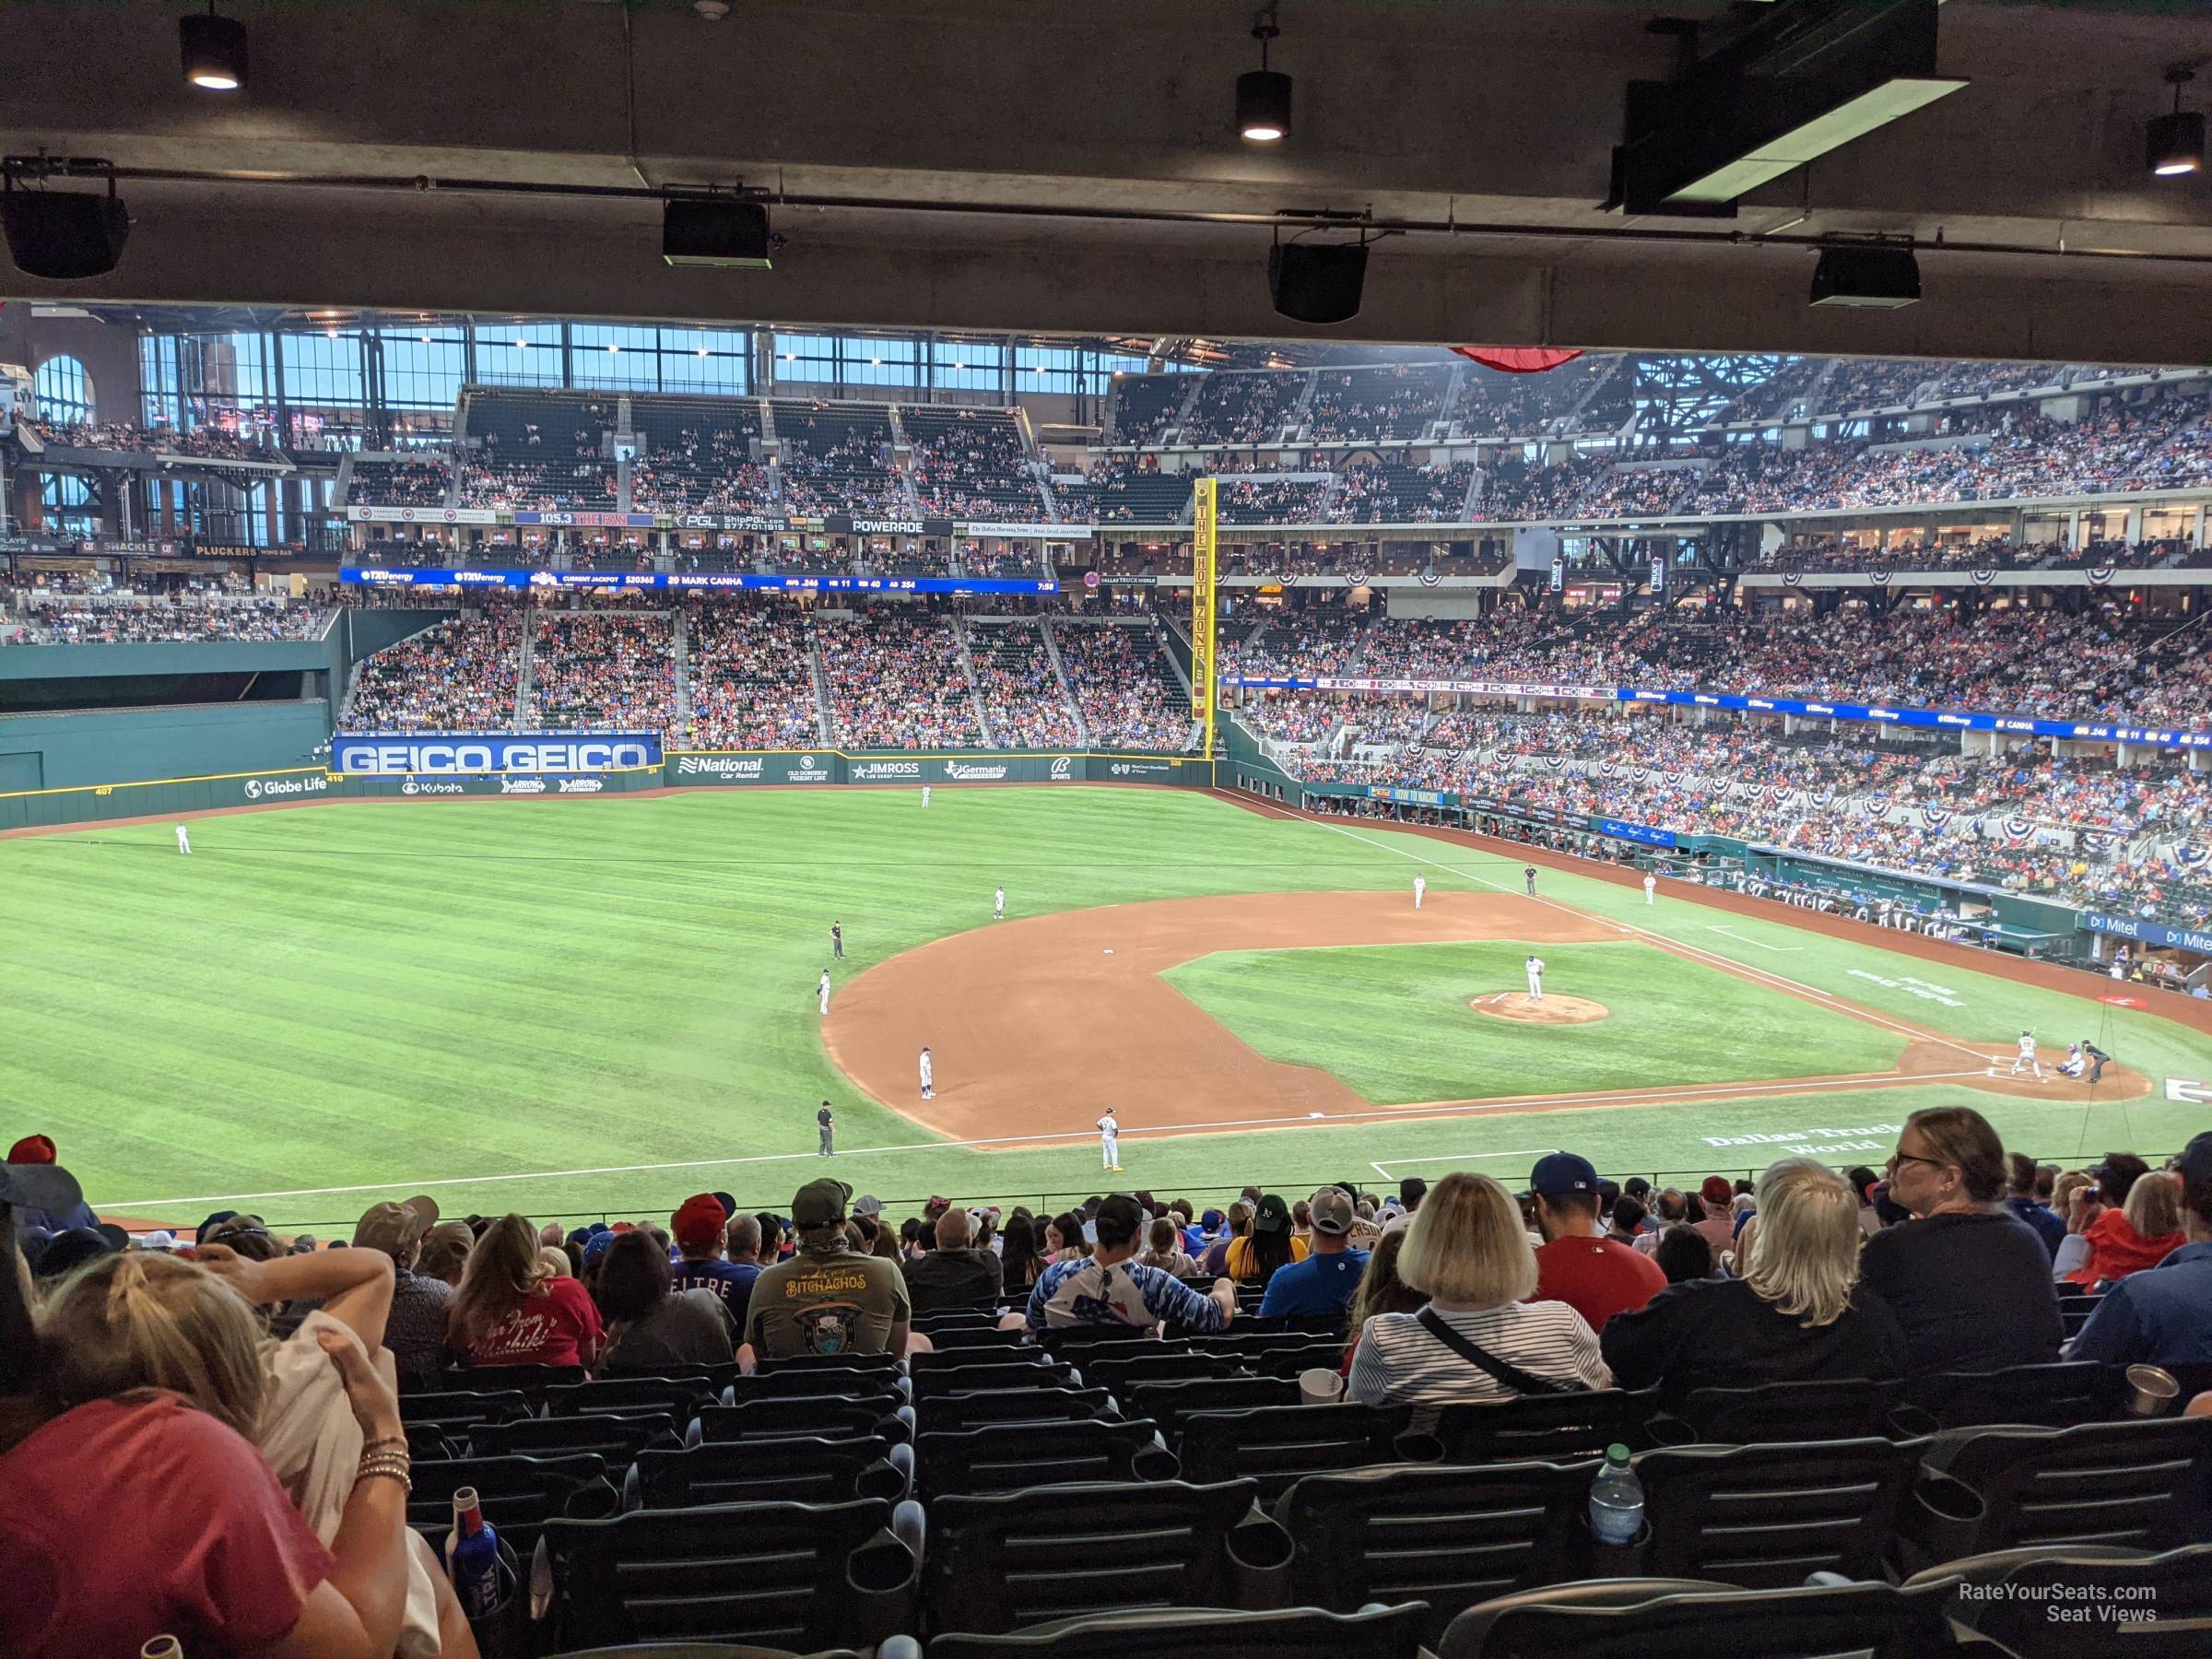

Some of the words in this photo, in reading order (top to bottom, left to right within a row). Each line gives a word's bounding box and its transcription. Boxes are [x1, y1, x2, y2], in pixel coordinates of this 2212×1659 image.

[539, 513, 572, 524] 105.3
[574, 514, 601, 524] THE
[602, 515, 628, 525] FAN
[687, 516, 718, 526] PGL
[724, 516, 784, 524] ShipPGL.com
[853, 520, 924, 533] POWERADE
[1197, 507, 1206, 546] THE
[195, 547, 257, 556] PLUCKERS
[370, 571, 414, 582] TXUenergy
[463, 572, 506, 582] TXUenergy
[667, 576, 679, 584] 20
[681, 576, 709, 584] MARK
[710, 577, 743, 585] CANHA
[1196, 558, 1206, 595] HOT
[1195, 606, 1206, 659] ZONE
[2006, 720, 2034, 730] CANHA
[341, 745, 493, 773] GEICO
[502, 744, 648, 771] GEICO
[962, 764, 1006, 774] Germania
[326, 774, 344, 783] 410
[512, 780, 541, 789] ARROW
[569, 779, 597, 788] ARROW
[95, 787, 112, 795] 407
[264, 781, 301, 794] Globe
[304, 779, 327, 792] Life
[421, 782, 465, 794] Kubota
[2106, 917, 2138, 936] Mitel
[2183, 933, 2212, 951] Mite
[1702, 1130, 1808, 1147] Dallas
[1782, 1139, 1887, 1156] World
